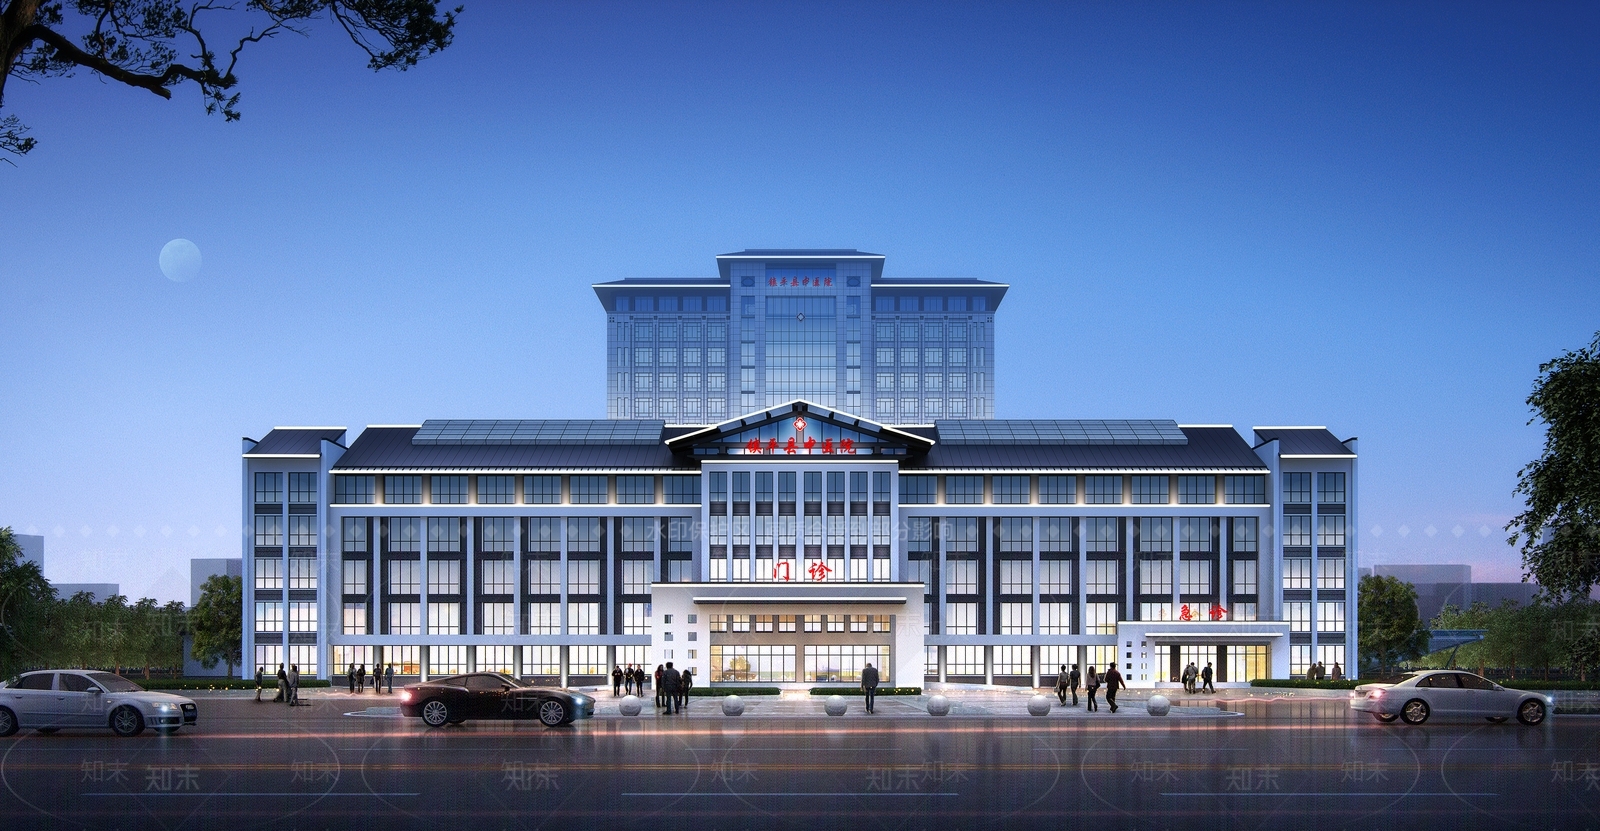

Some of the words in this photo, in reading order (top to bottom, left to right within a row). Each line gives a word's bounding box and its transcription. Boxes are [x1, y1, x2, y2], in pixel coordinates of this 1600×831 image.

[768, 276, 833, 287] 镇平县中医院
[746, 436, 856, 454] 镇平县中医院
[773, 561, 833, 582] 门诊
[1179, 604, 1228, 621] 急诊
